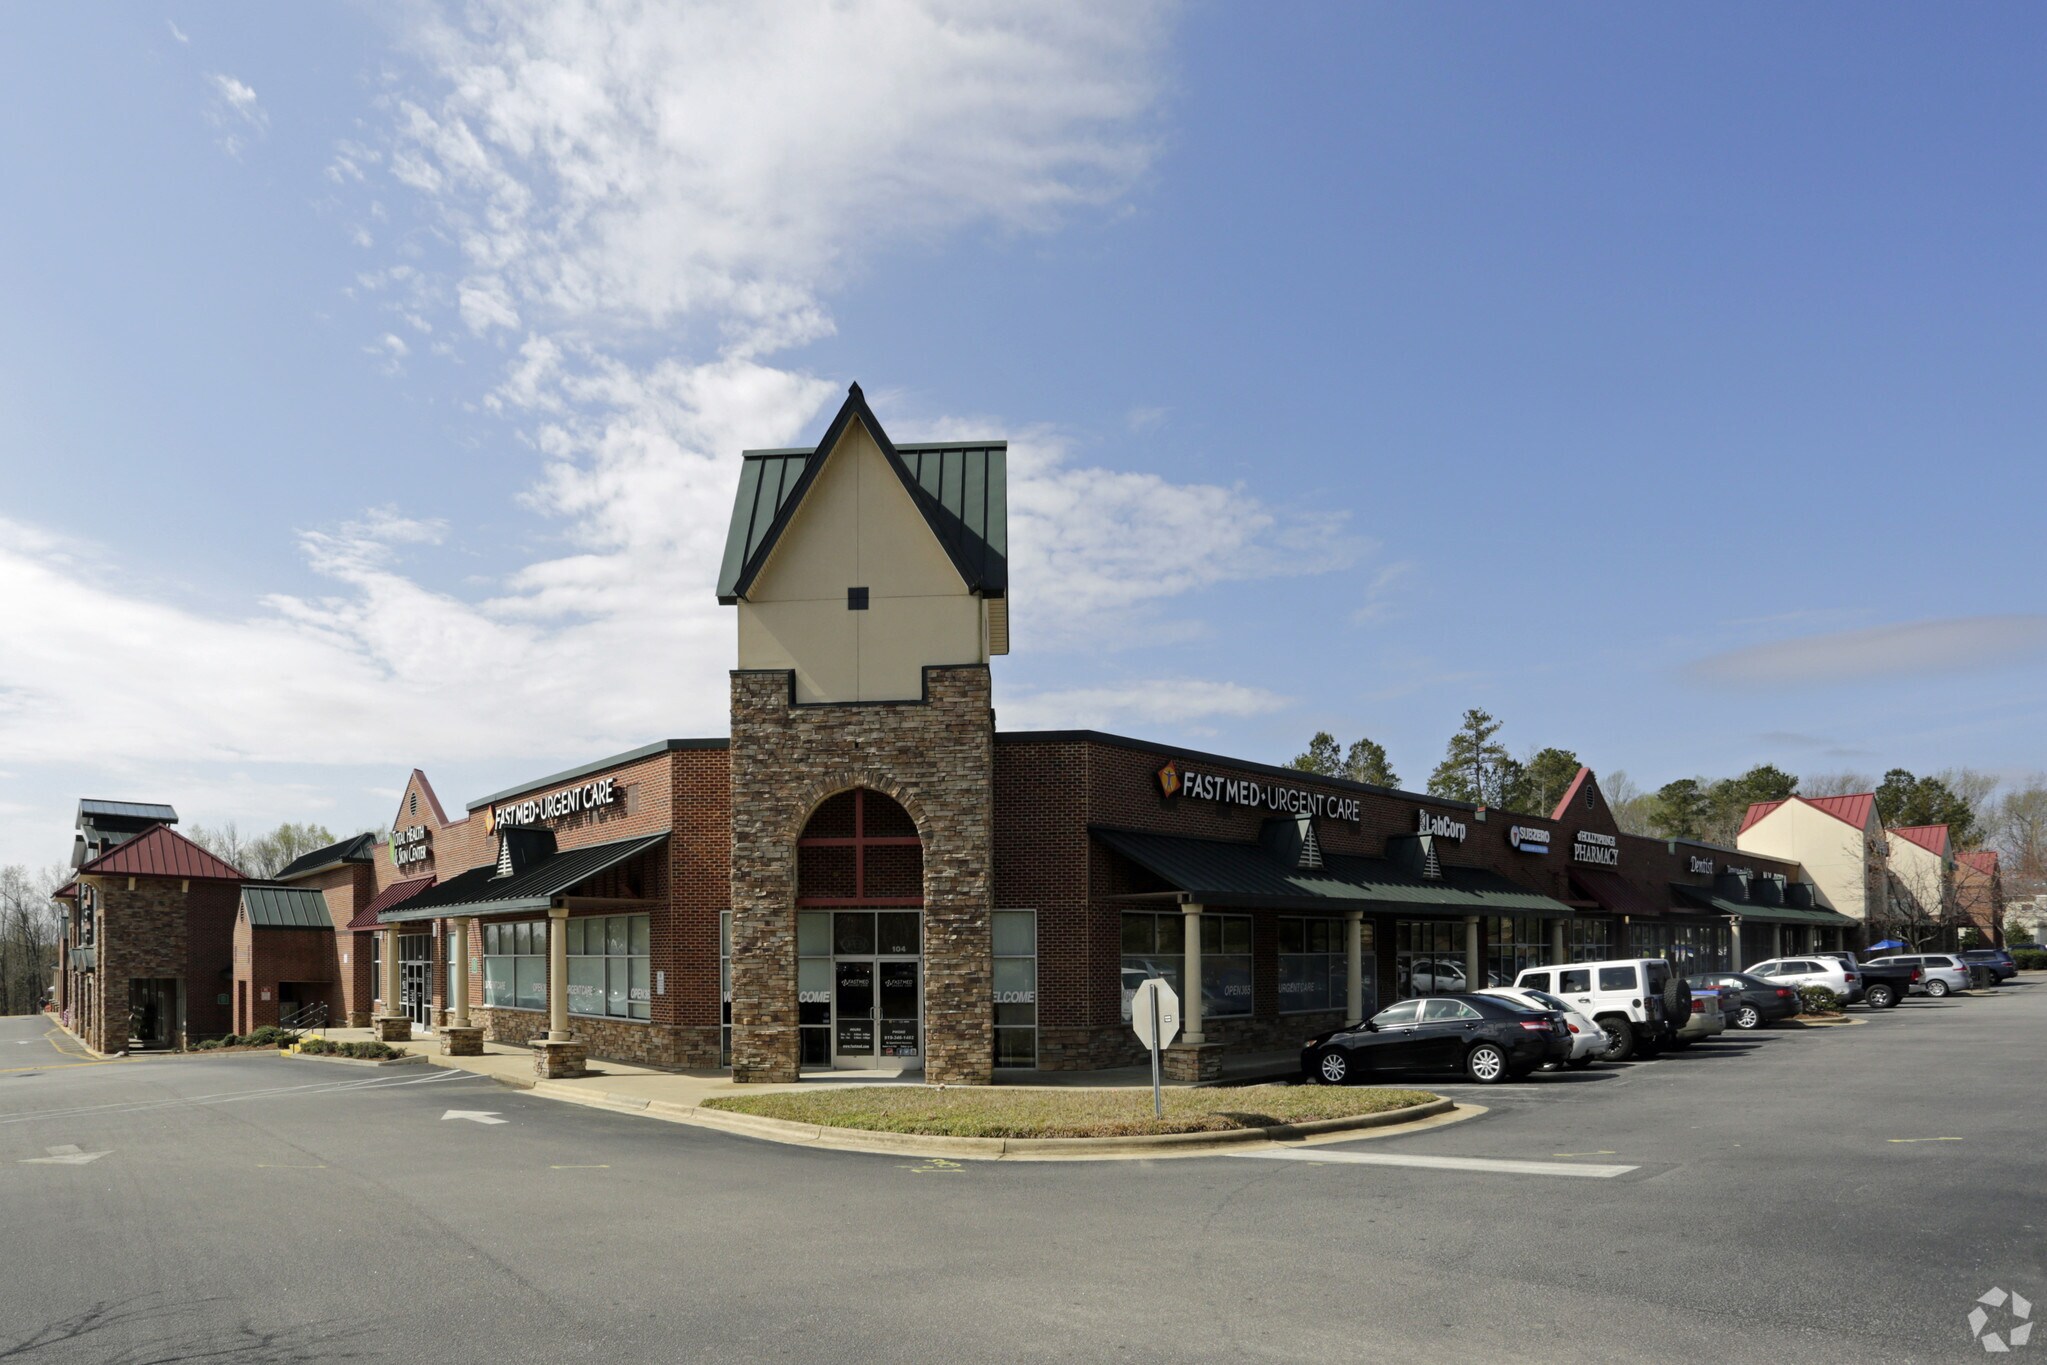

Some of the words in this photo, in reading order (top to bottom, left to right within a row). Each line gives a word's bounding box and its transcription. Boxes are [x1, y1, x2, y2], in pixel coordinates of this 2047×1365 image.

[540, 788, 581, 820] URGENT
[583, 778, 614, 809] CARE
[1267, 786, 1324, 816] URGENT
[1327, 797, 1360, 822] CARE
[1425, 813, 1466, 843] LabCorp
[1574, 843, 1619, 865] PHARMACY
[1690, 855, 1714, 874] Dentist
[892, 945, 906, 953] 104
[1224, 985, 1241, 997] OPEN
[1278, 982, 1300, 993] URGENT
[1300, 981, 1315, 992] CARE
[799, 990, 831, 1003] COME
[993, 991, 1035, 1003] ELCOME
